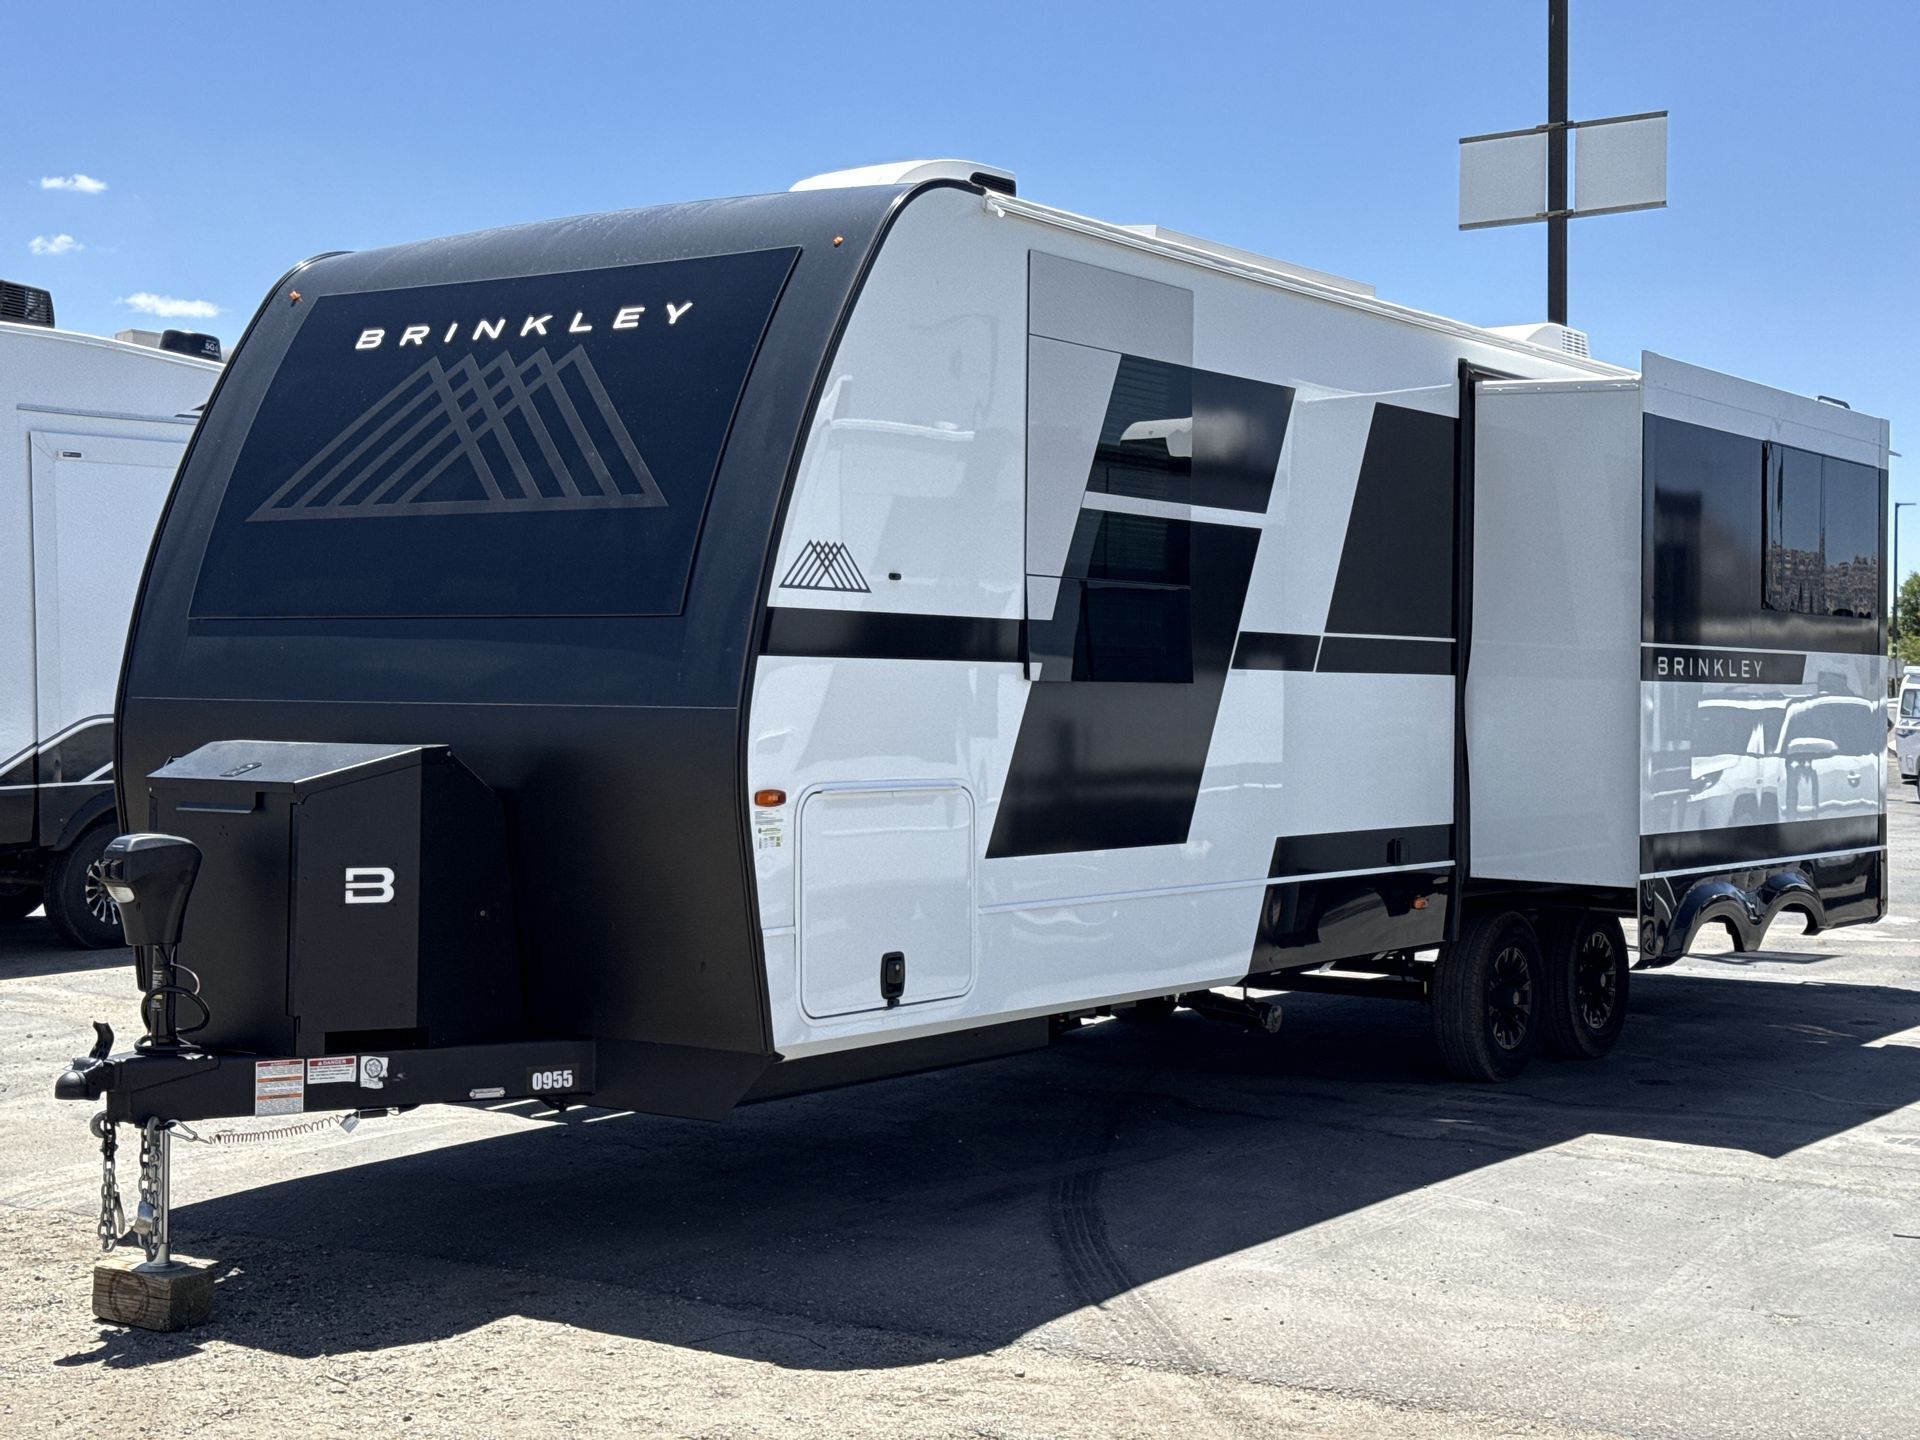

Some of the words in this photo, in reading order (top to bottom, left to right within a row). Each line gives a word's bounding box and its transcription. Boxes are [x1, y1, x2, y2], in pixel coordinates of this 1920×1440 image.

[355, 301, 693, 350] BRINKLEY
[1657, 656, 1763, 678] BRINKLEY
[345, 867, 395, 904] B
[532, 1069, 573, 1091] 0955
